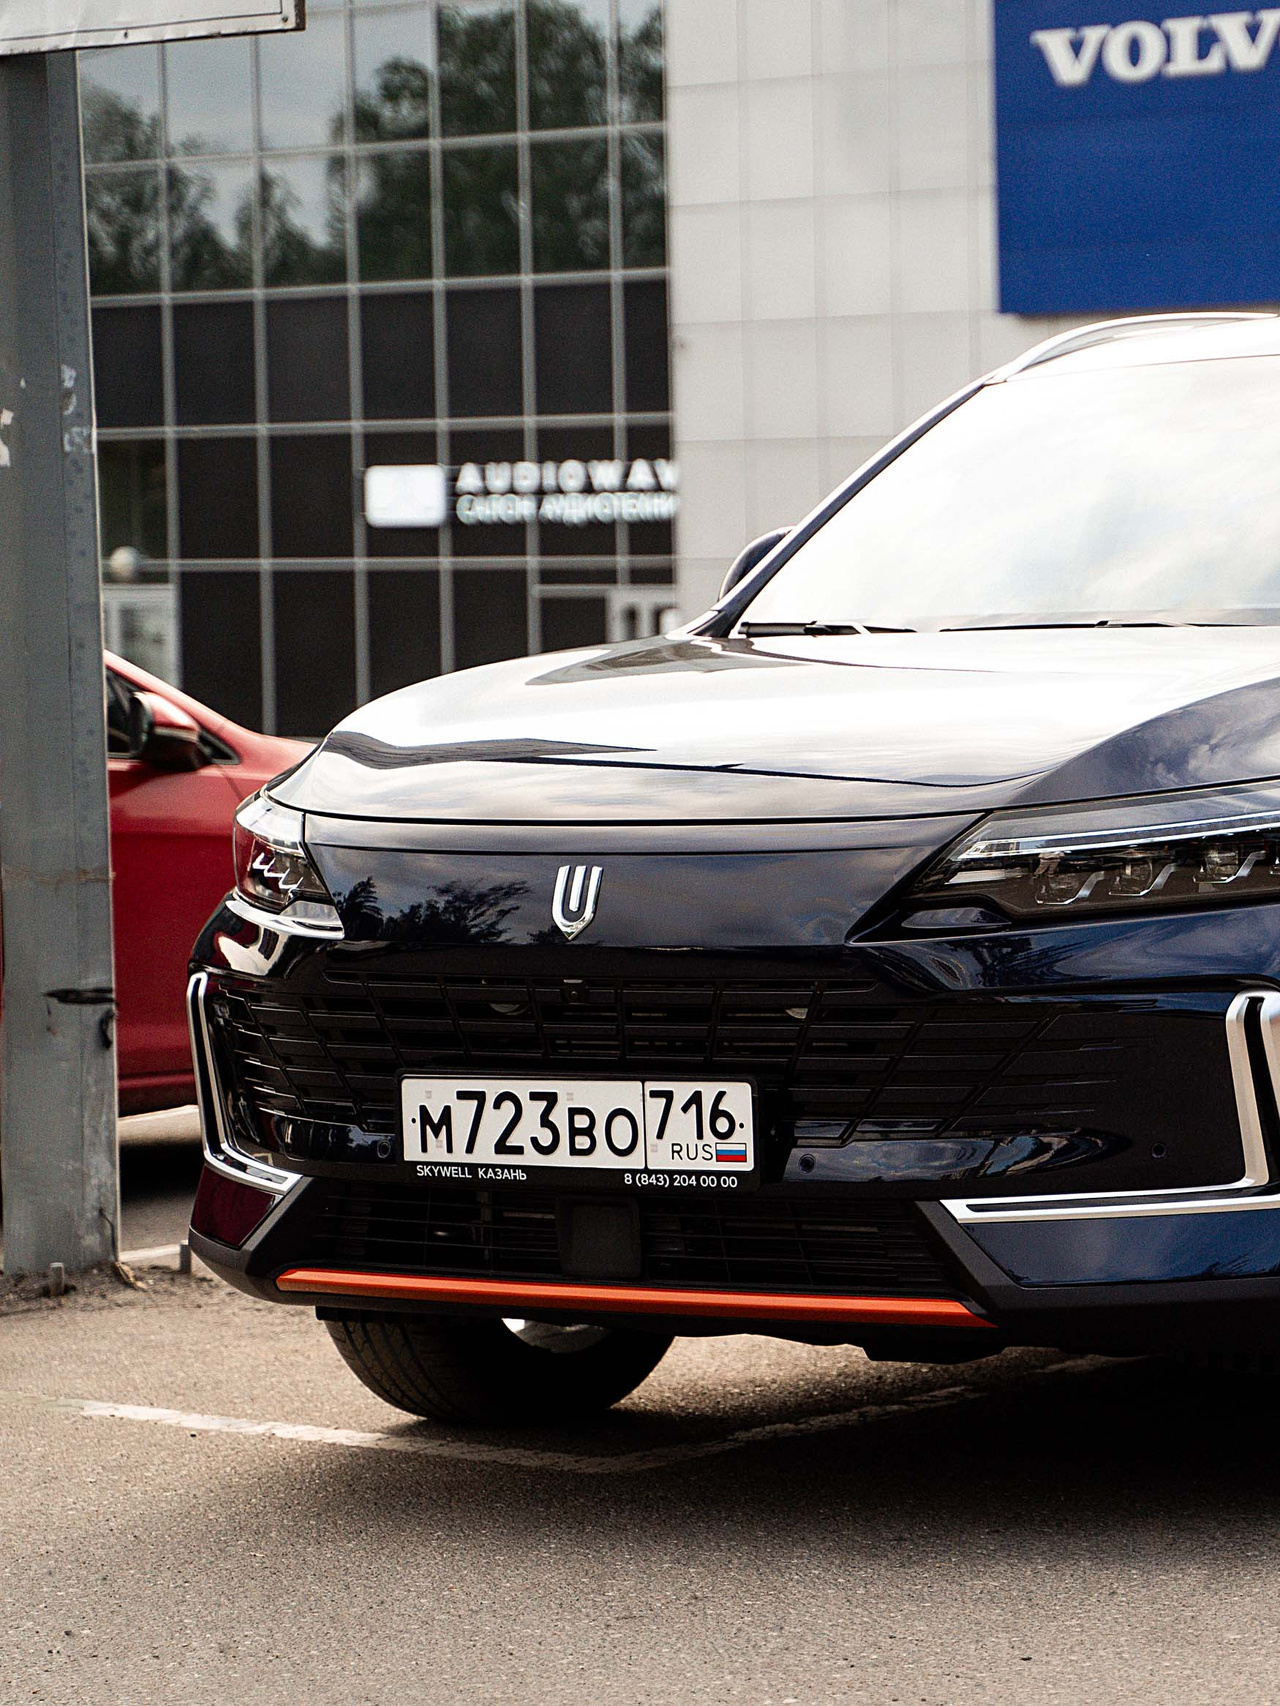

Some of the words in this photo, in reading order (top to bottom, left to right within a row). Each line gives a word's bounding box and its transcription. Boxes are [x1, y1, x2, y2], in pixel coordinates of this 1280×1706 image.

[649, 1089, 736, 1141] 716
[671, 1142, 714, 1161] RUS
[416, 1164, 473, 1178] SKYWELL
[477, 1167, 527, 1180] КАЗАНЬ
[624, 1173, 632, 1185] 8
[635, 1173, 670, 1187] (843)
[673, 1175, 697, 1187] 204
[700, 1176, 717, 1187] 00
[720, 1176, 738, 1188] 00
